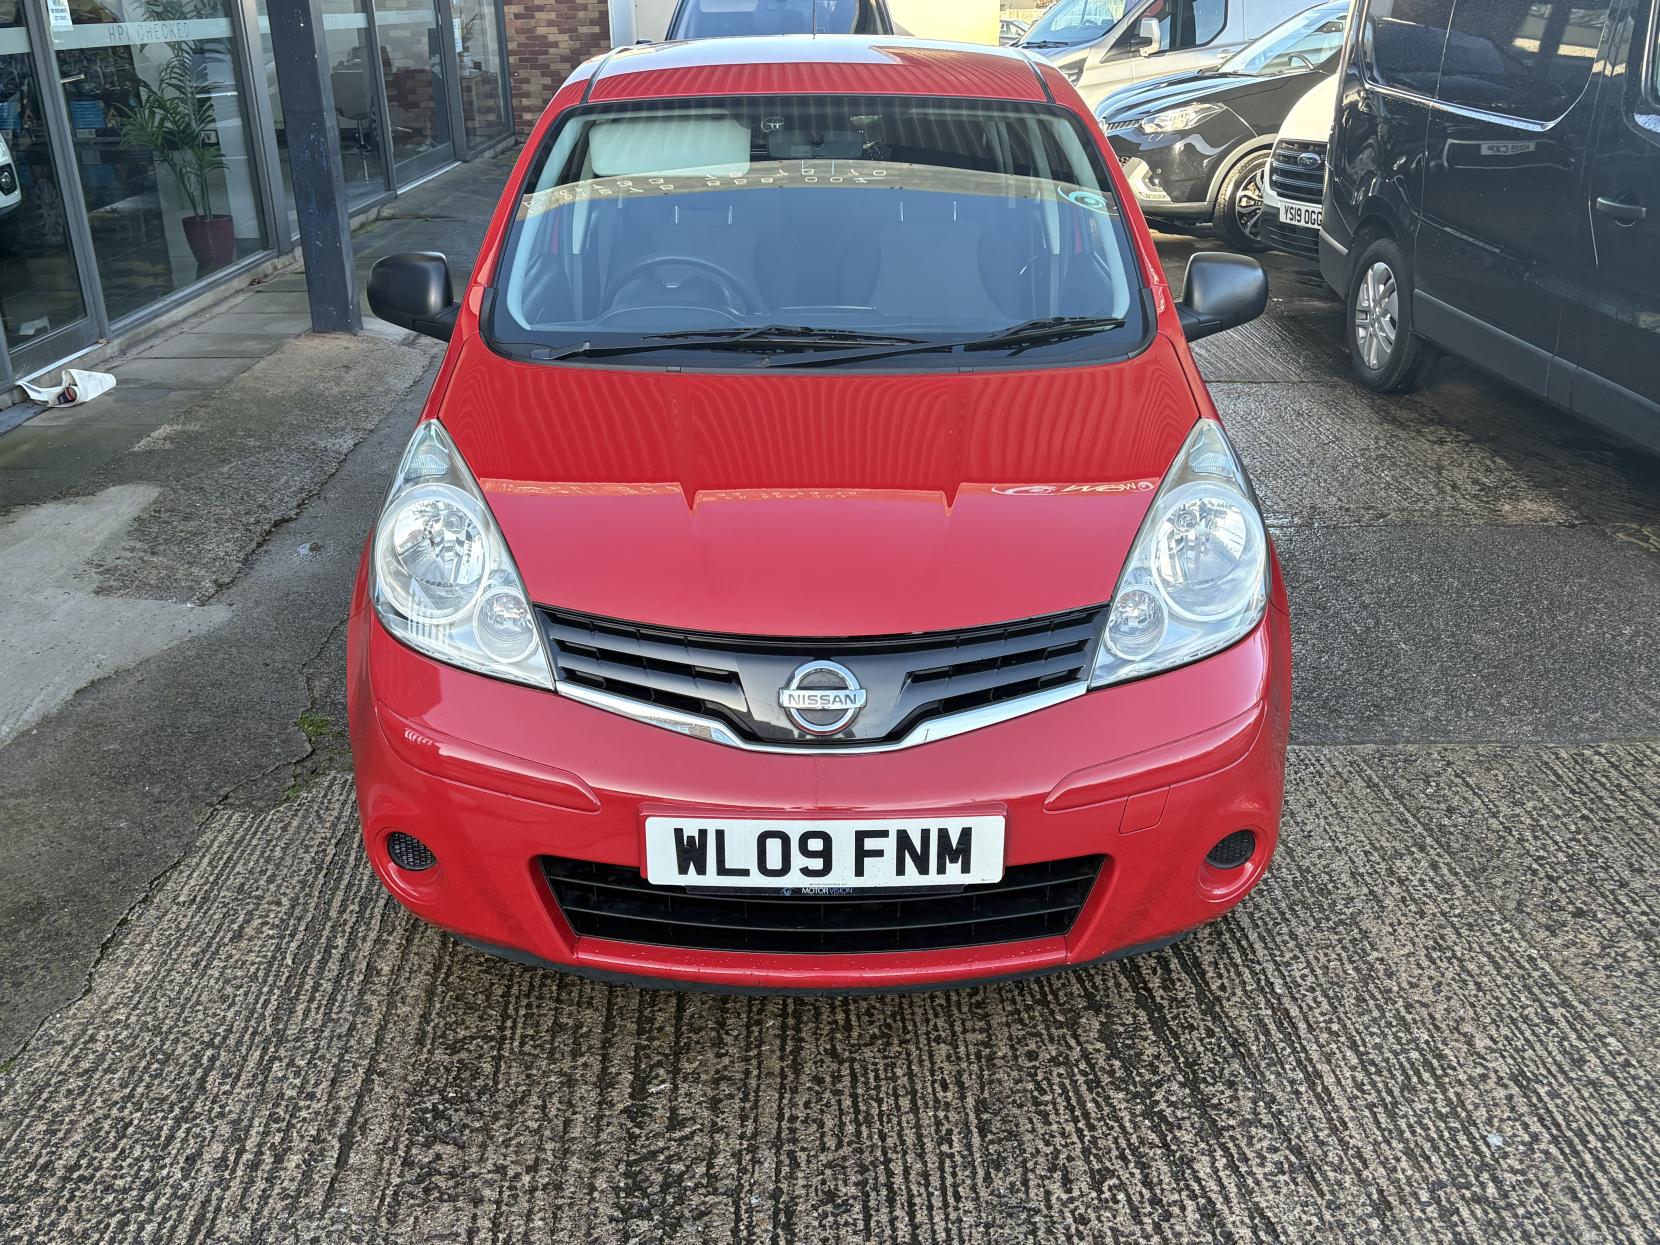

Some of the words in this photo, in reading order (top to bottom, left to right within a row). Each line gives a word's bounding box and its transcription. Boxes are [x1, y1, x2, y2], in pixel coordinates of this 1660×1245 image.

[108, 25, 130, 43] HPI
[136, 21, 191, 41] CHECKED
[1284, 205, 1302, 222] YS19
[788, 693, 857, 706] NISSAN
[673, 827, 834, 878] WL09
[854, 826, 973, 877] FNM
